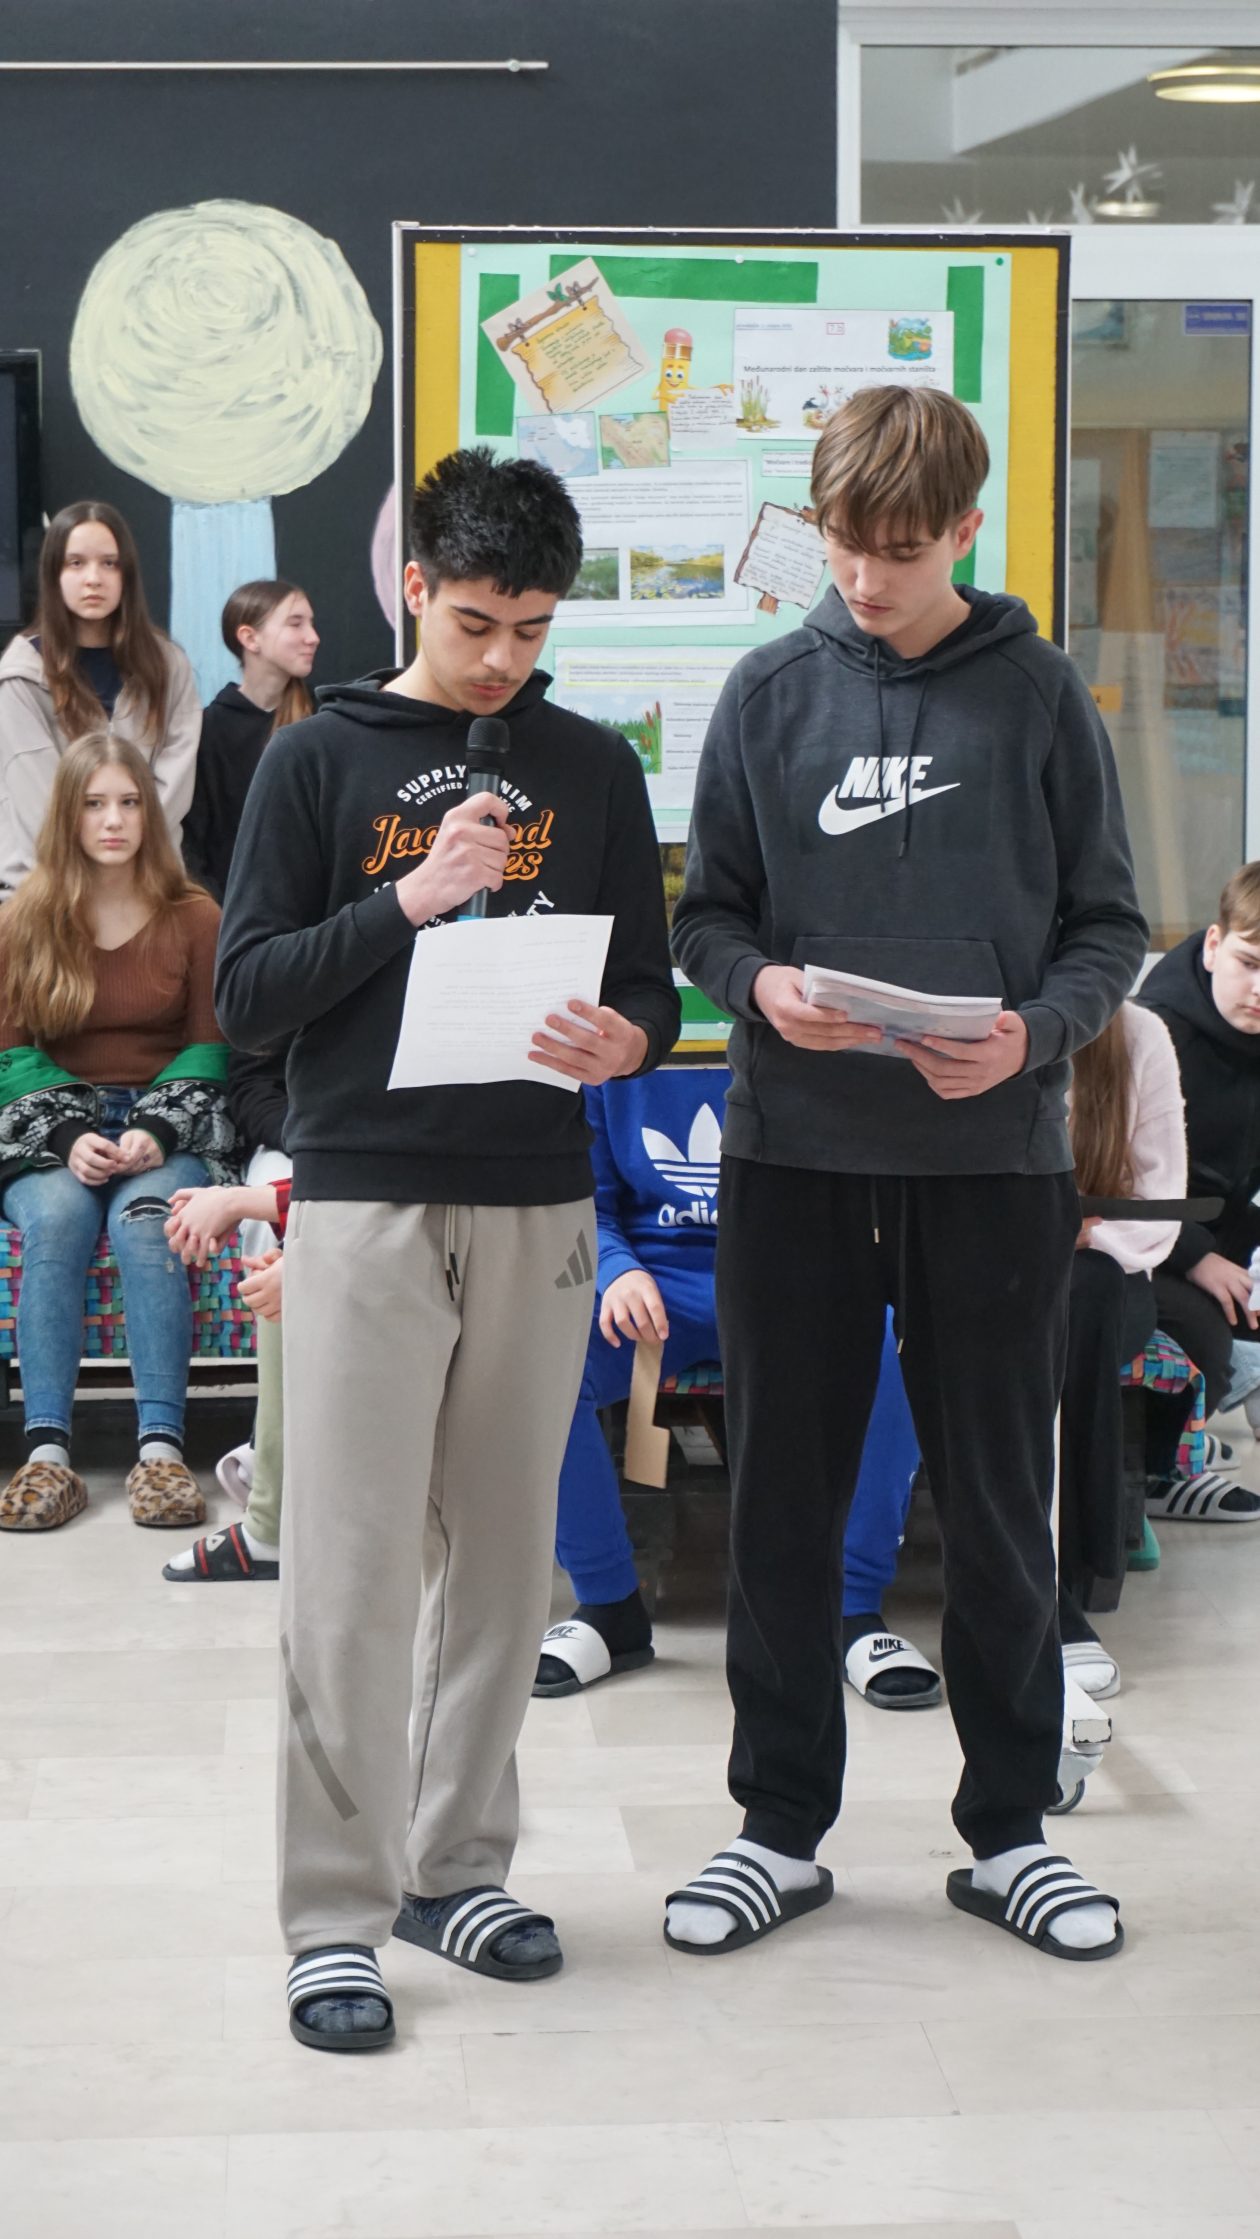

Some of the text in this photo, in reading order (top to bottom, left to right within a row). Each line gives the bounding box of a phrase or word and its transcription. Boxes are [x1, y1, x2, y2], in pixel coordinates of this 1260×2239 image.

[397, 765, 467, 802] SUPPLY
[500, 779, 533, 812] NIM
[415, 782, 463, 805] CERTIFIED
[838, 756, 933, 800] NIKE
[361, 814, 442, 875] Jac
[658, 1200, 719, 1228] adi
[873, 1638, 905, 1652] NIKE
